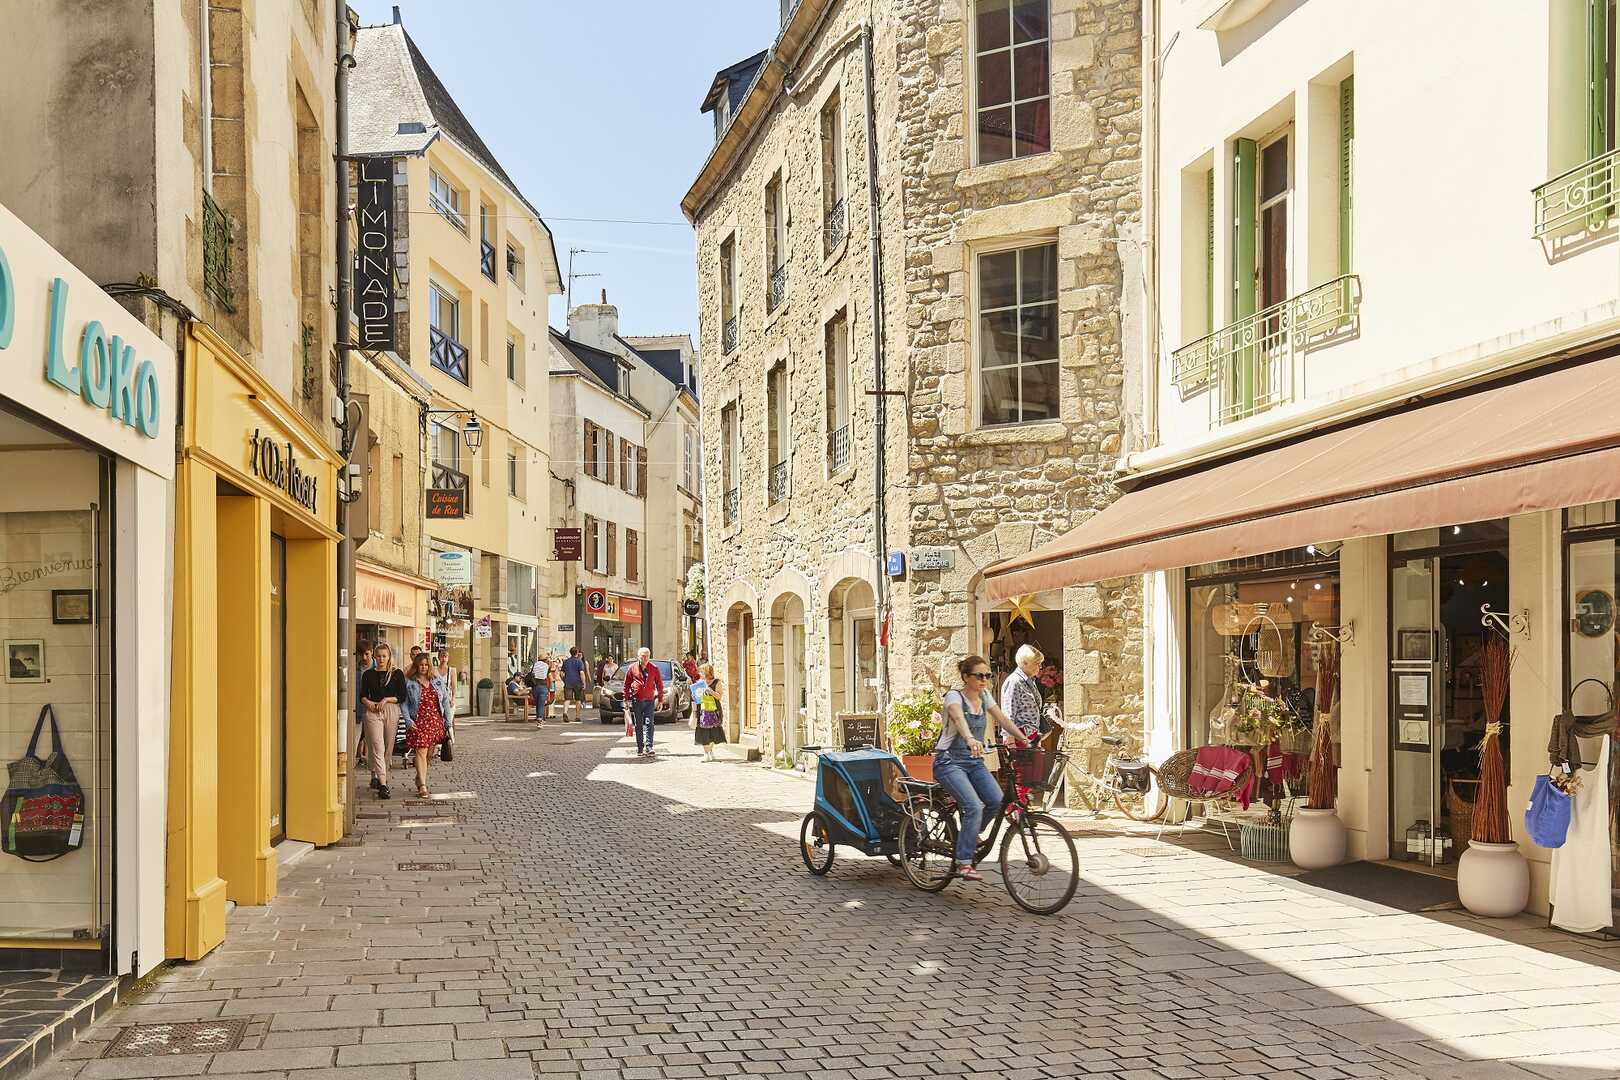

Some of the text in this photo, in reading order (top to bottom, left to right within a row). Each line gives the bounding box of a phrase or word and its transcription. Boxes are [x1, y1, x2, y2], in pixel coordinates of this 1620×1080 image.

[361, 163, 390, 342] LIMONADE
[48, 277, 160, 440] LOKO
[431, 492, 459, 504] Cuisine
[431, 505, 459, 515] de Rue
